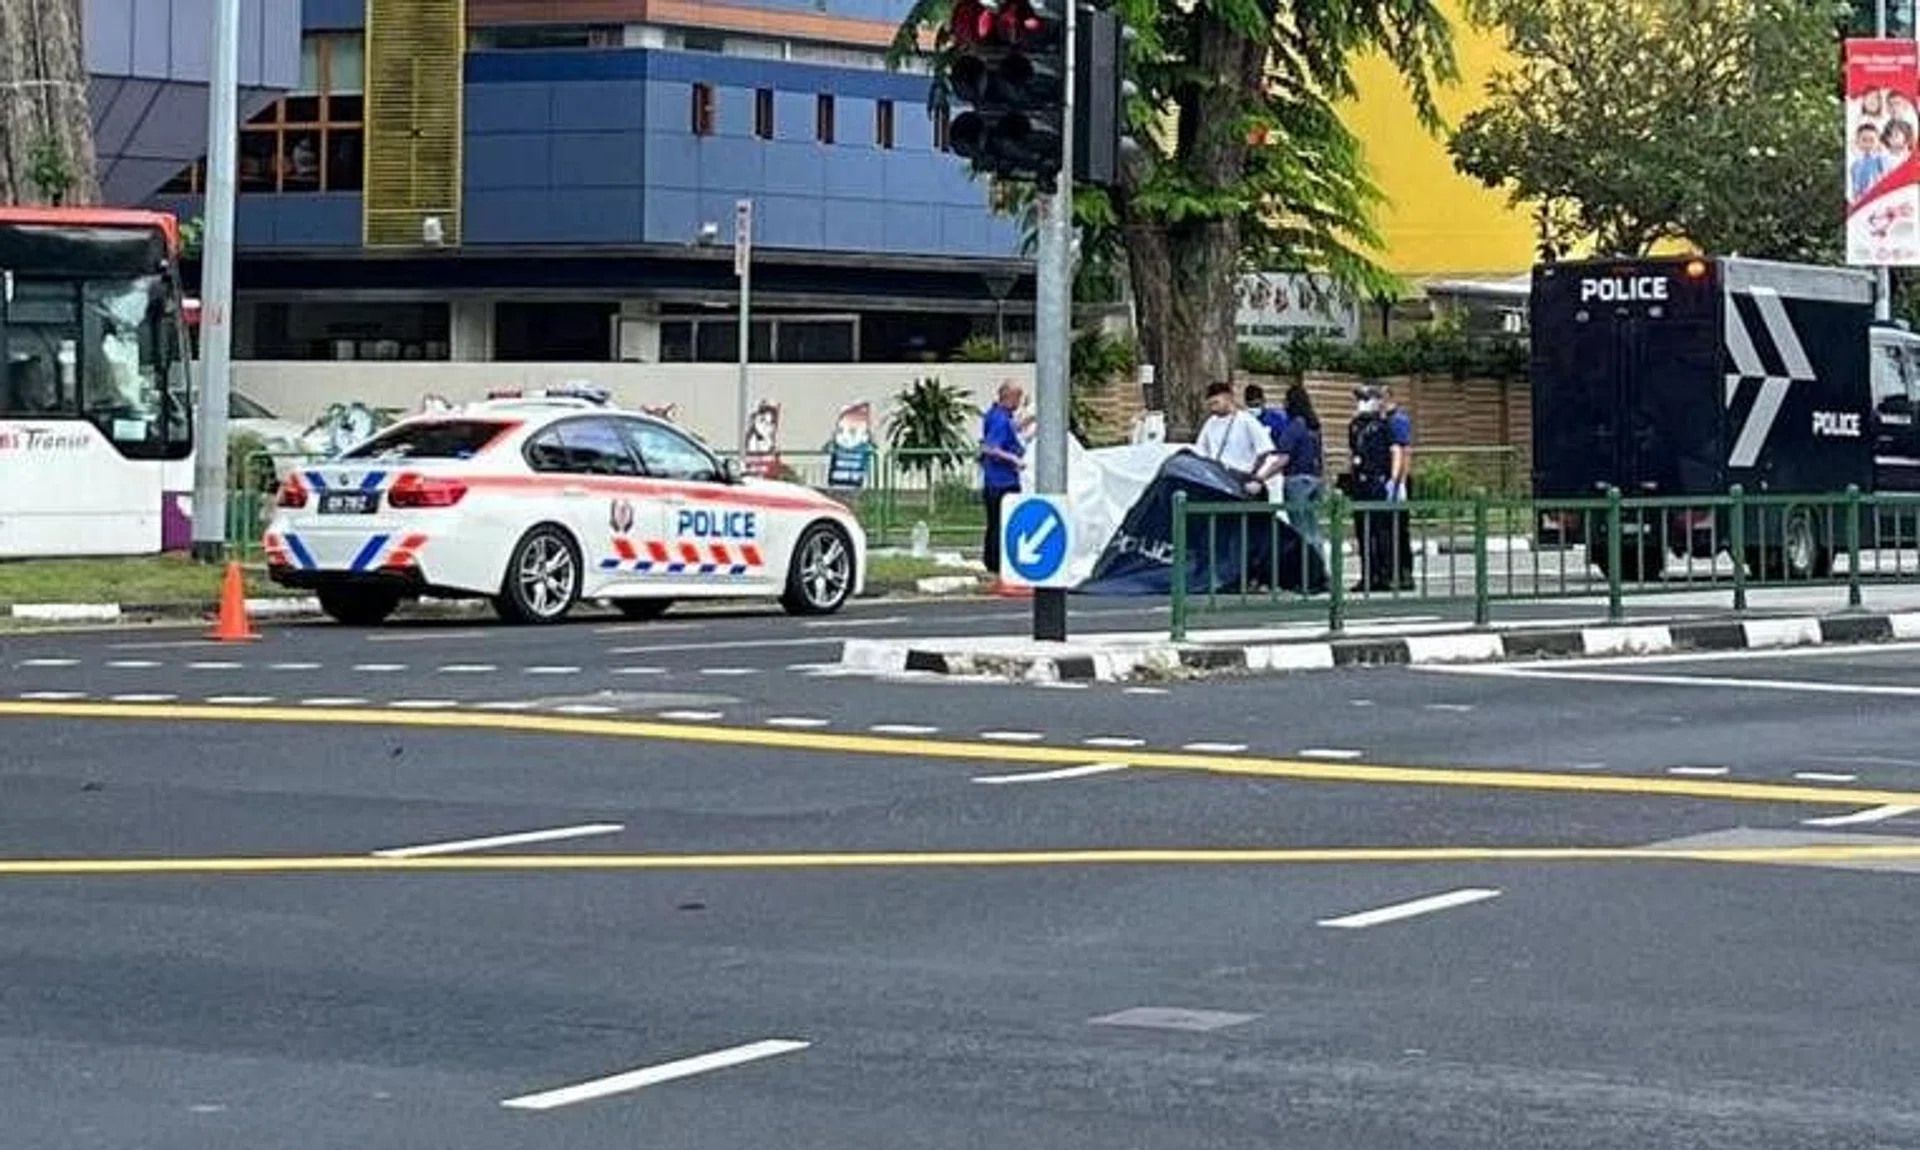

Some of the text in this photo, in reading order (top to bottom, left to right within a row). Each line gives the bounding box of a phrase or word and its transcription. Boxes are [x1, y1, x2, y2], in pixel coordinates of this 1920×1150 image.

[1581, 276, 1669, 302] POLICE
[1812, 410, 1861, 436] POLICE
[678, 510, 756, 538] POLICE
